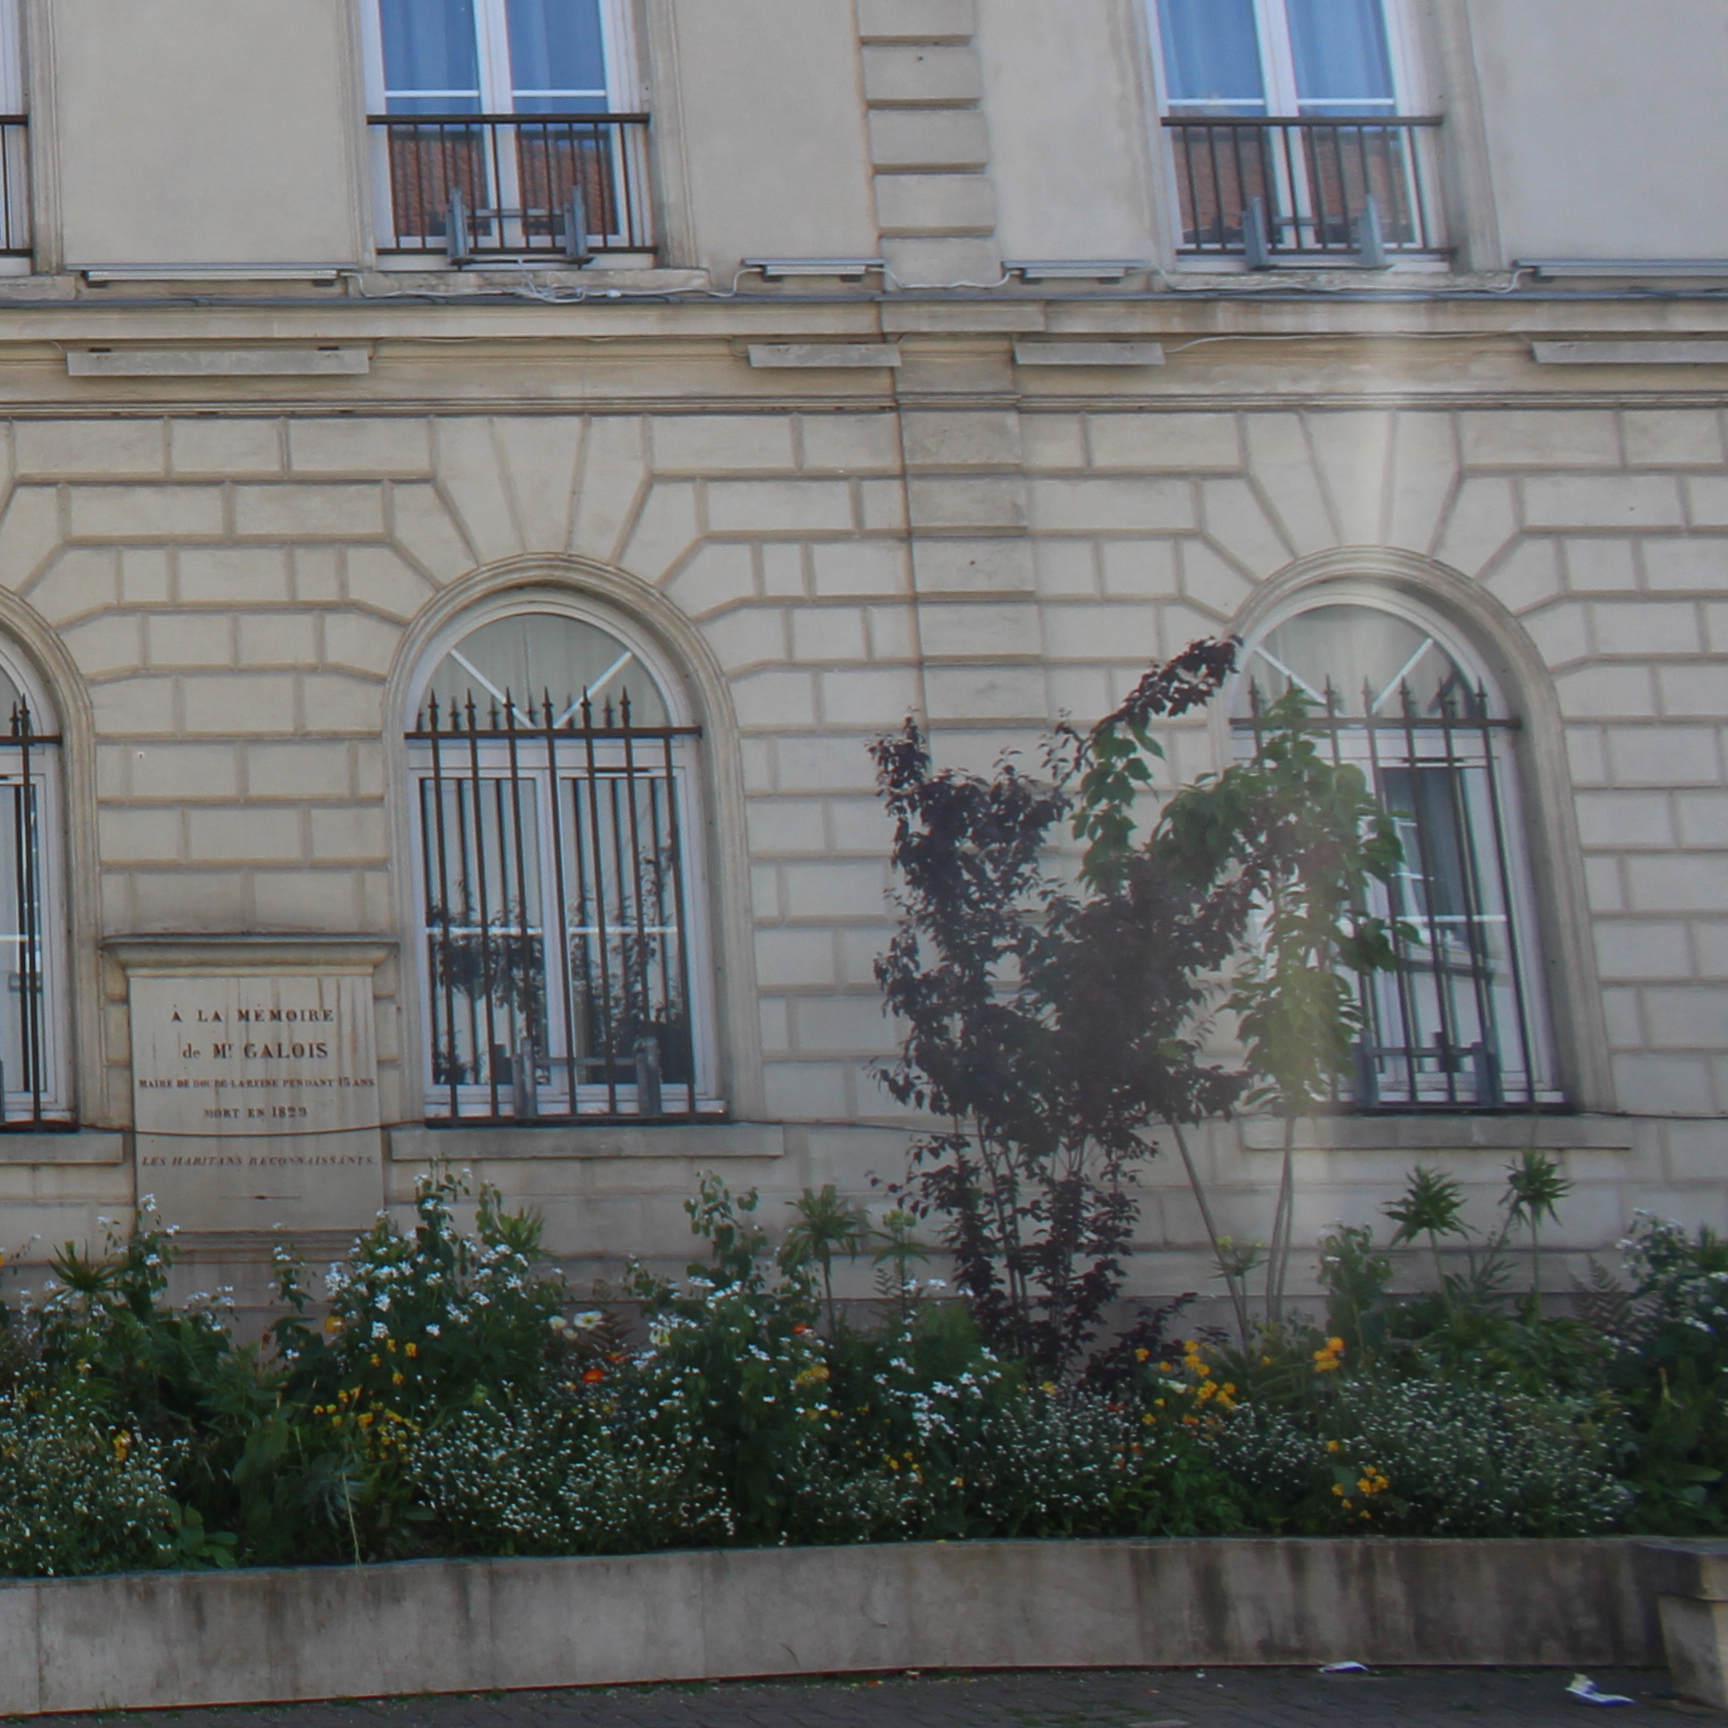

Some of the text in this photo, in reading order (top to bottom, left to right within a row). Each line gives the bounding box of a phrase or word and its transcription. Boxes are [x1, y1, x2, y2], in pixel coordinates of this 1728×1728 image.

[196, 1009, 223, 1022] LA
[236, 1003, 334, 1022] MÉMOIRE
[182, 1042, 201, 1058] de
[244, 1042, 328, 1059] GALOIS
[138, 1079, 171, 1088] MAIRE
[177, 1079, 189, 1088] DE
[283, 1078, 333, 1087] PENDANT
[339, 1076, 350, 1086] 15
[352, 1078, 375, 1087] ANS
[203, 1106, 307, 1118] MORT EN 1829
[141, 1156, 166, 1165] LES
